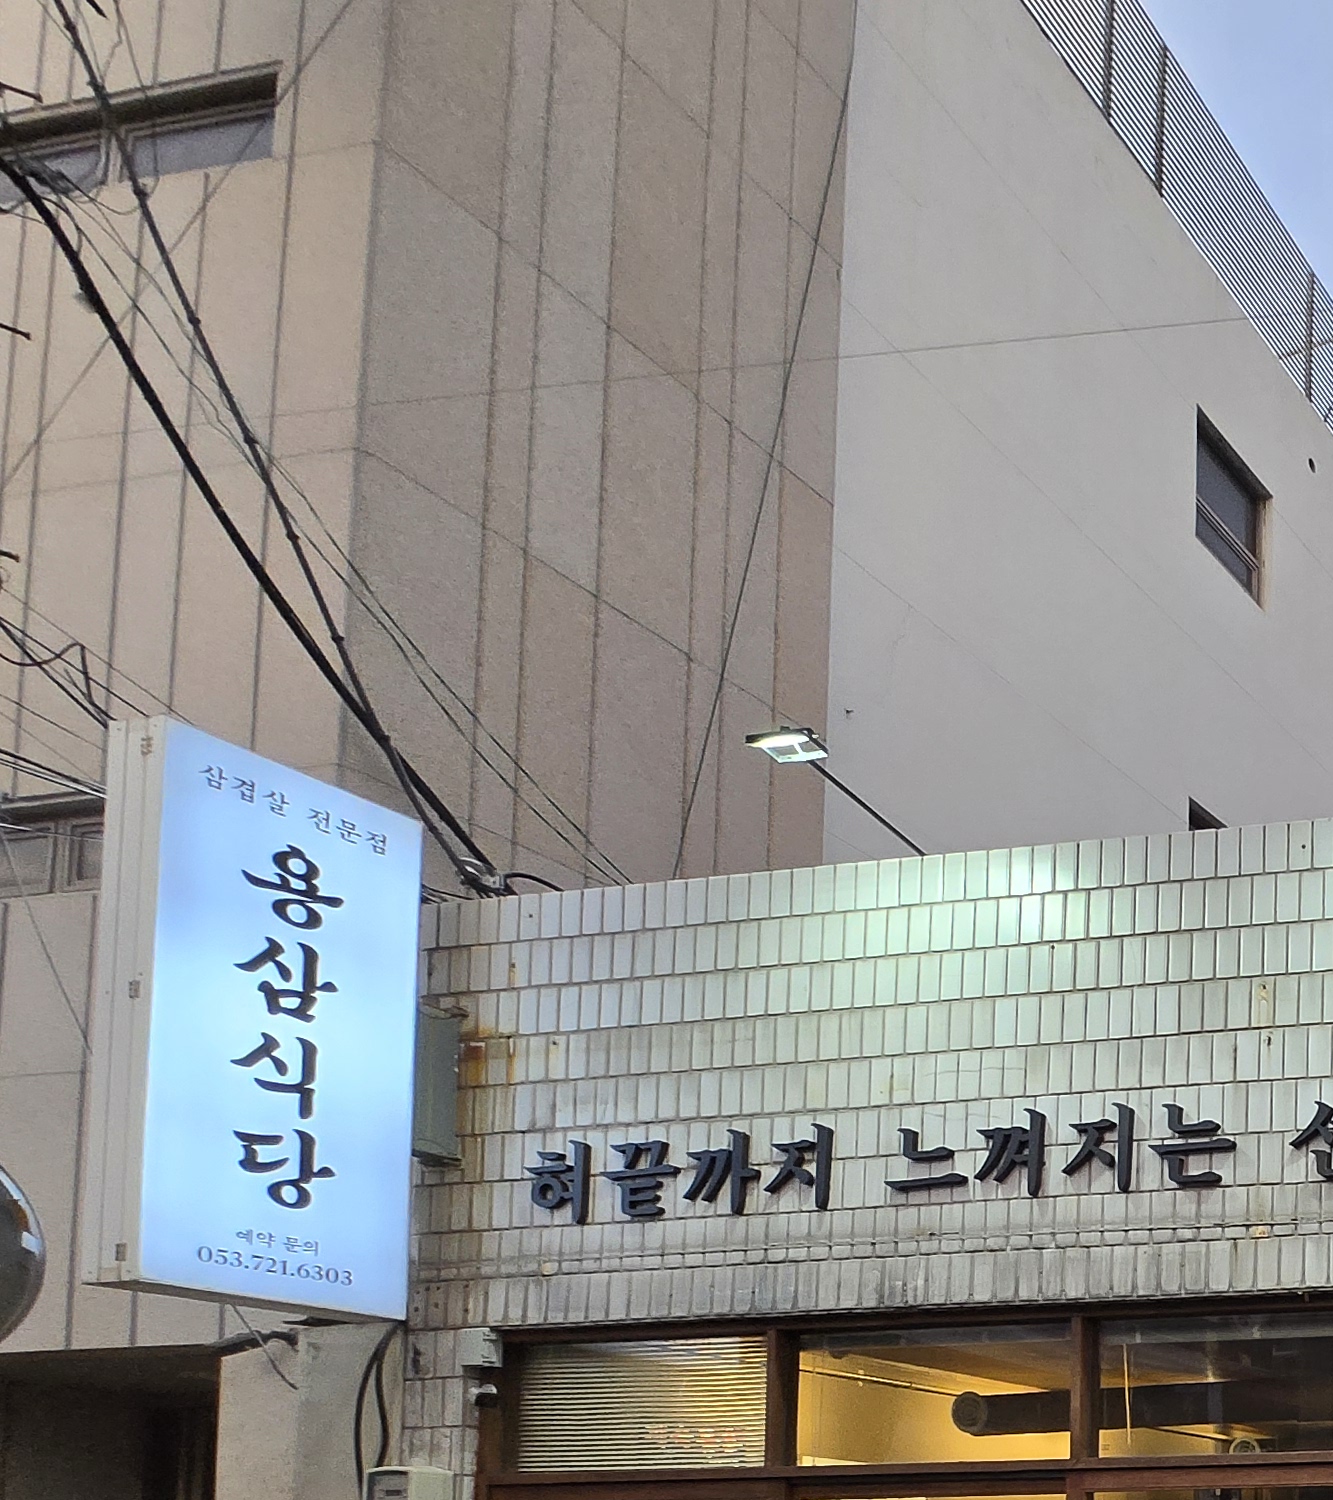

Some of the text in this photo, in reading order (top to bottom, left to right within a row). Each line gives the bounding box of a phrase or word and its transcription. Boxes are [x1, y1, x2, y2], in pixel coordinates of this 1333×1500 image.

[198, 763, 390, 858] 삼겹살 전문점
[231, 843, 344, 1213] 용삼식당
[524, 1122, 834, 1225] 혀끝까지
[884, 1103, 1237, 1198] 느껴지는
[197, 1244, 354, 1287] 053.721.6303
[235, 1228, 319, 1257] 예약 문의
